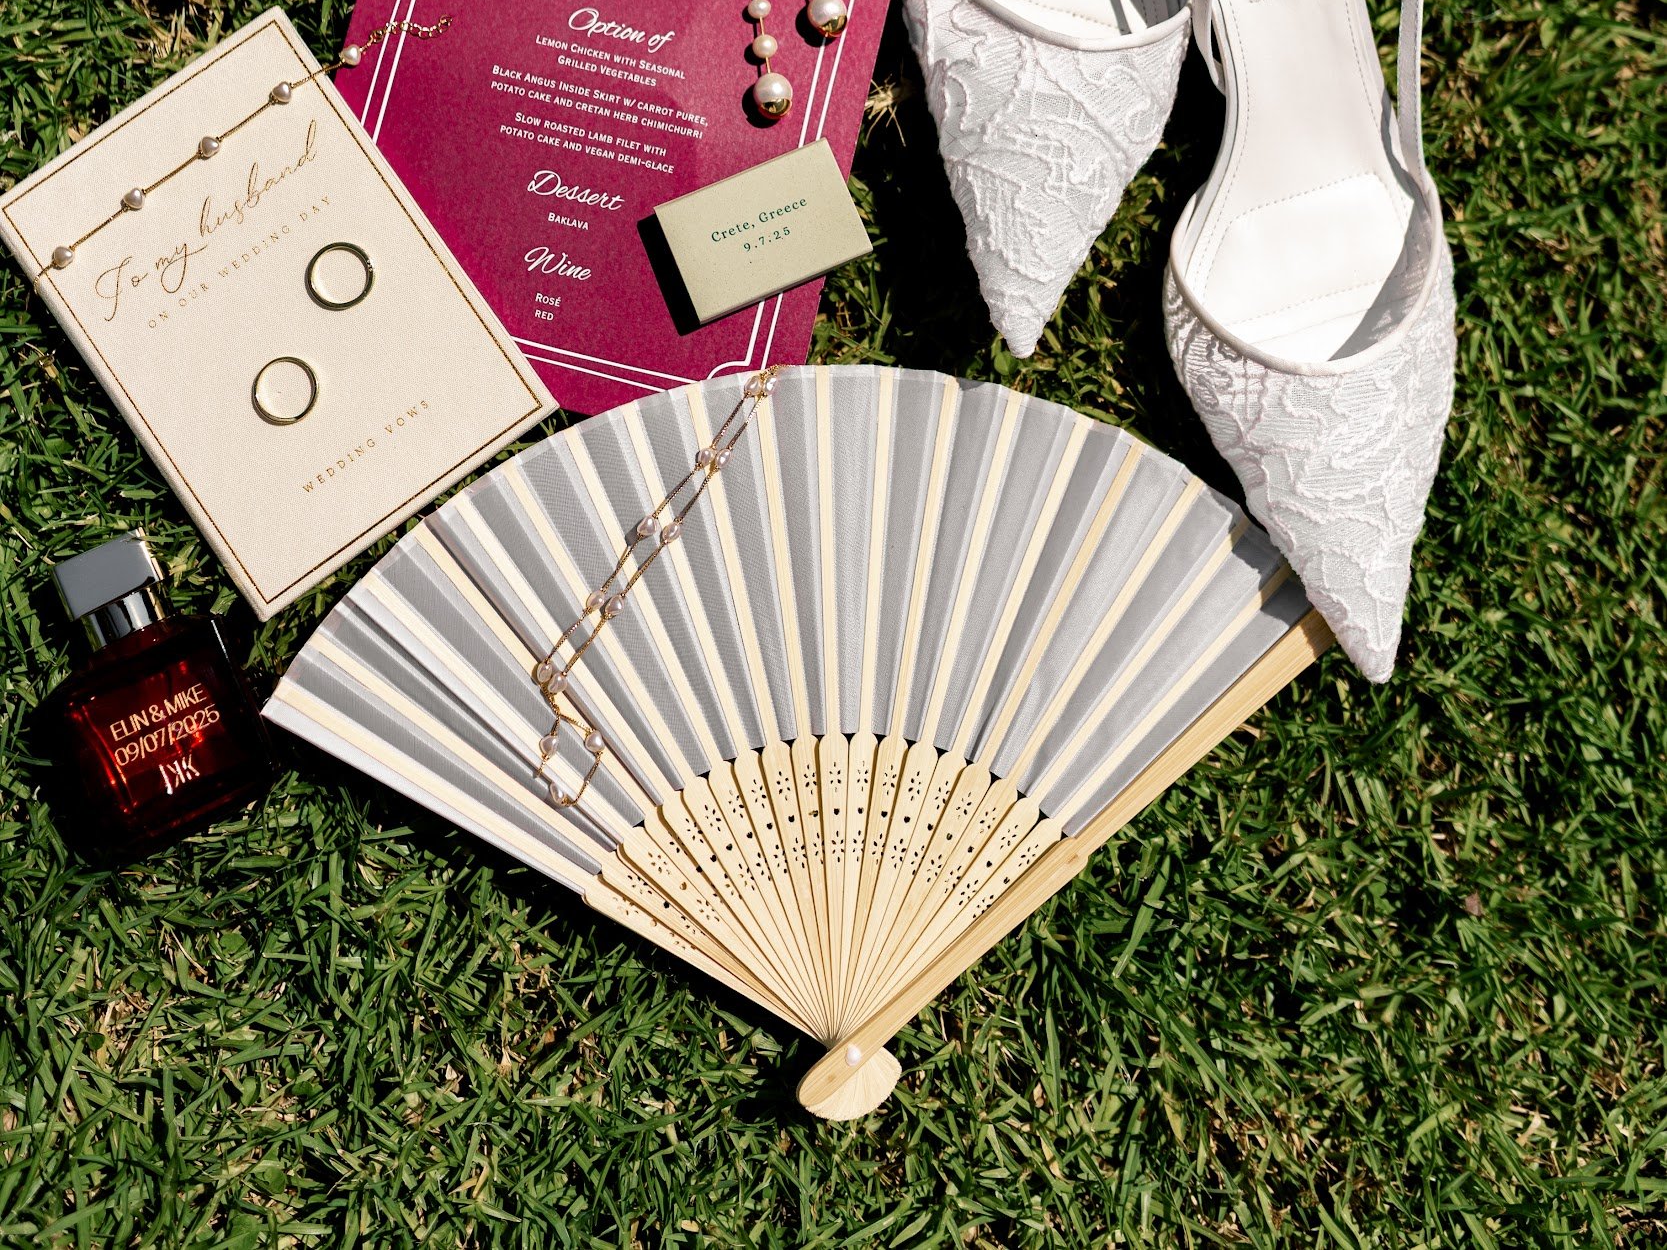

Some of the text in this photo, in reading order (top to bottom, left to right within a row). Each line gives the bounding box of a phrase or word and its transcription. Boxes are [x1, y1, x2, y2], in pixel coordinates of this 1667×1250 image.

[568, 7, 675, 54] Option of
[535, 34, 686, 80] LEMON CHICKEN WITH SEASONAL
[557, 55, 657, 87] GRILLED VEGETABLES
[491, 81, 703, 139] POTATO CAKE AND CRETAN HERB CHIMICHURRI
[492, 65, 522, 80] BLACK
[523, 73, 556, 88] ANGUS
[558, 80, 591, 98] INSIDE
[592, 89, 621, 104] SKIRT
[637, 102, 674, 117] CARROT
[500, 125, 535, 141] POTATO
[537, 134, 561, 147] CAKE
[562, 140, 583, 152] AND
[585, 146, 615, 160] VEGAN
[515, 112, 667, 157] SLOW ROASTED LAMB FILET WITH
[527, 169, 625, 211] Dessert
[95, 119, 317, 322] To my husband
[547, 212, 589, 230] BAKLAVA
[711, 197, 808, 243] Crete, Greece
[743, 226, 791, 252] 9.7.25
[148, 195, 331, 328] ON OUR WEDDING DAY
[524, 246, 592, 281] Wine
[534, 309, 554, 321] RED
[302, 400, 429, 493] WEDDING VOWS
[109, 682, 207, 742] ELIN & MIKE
[114, 703, 220, 767] 09/07/2025
